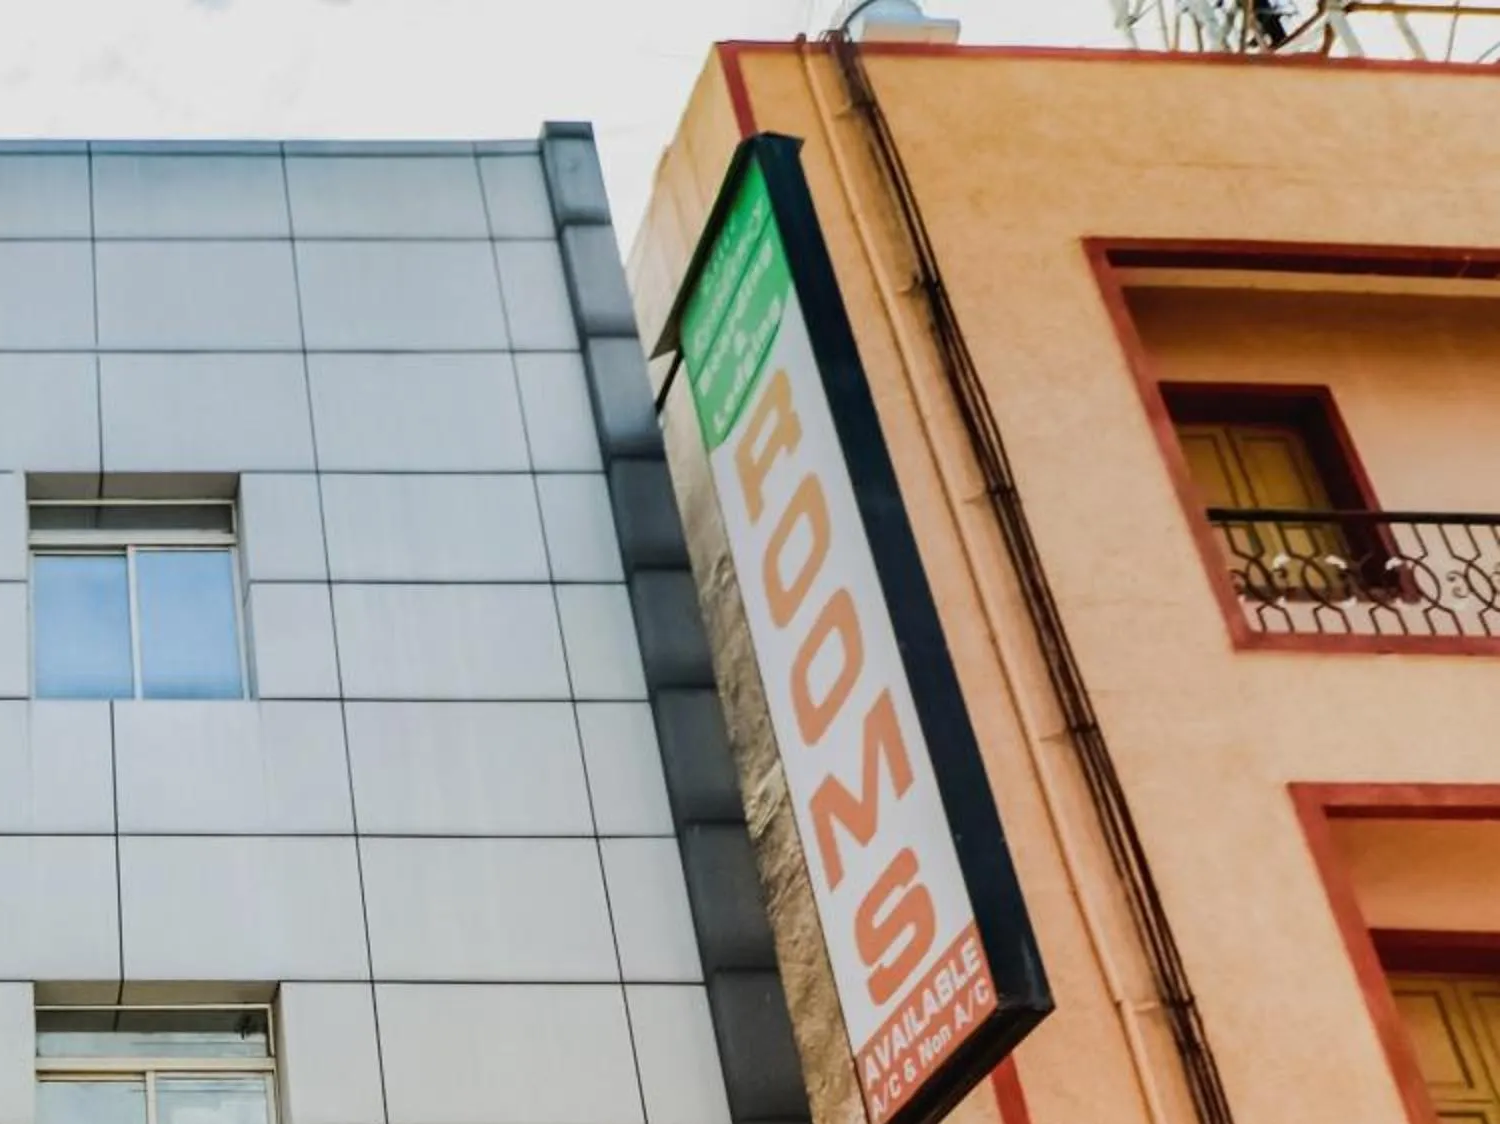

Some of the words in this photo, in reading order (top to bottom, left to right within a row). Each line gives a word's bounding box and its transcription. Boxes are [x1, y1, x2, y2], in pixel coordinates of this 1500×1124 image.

[734, 368, 937, 1006] ROOMS
[862, 936, 983, 1089] AVAILABLE
[869, 1082, 901, 1118] A/C
[919, 1027, 953, 1060] Non
[953, 980, 991, 1033] A/C
